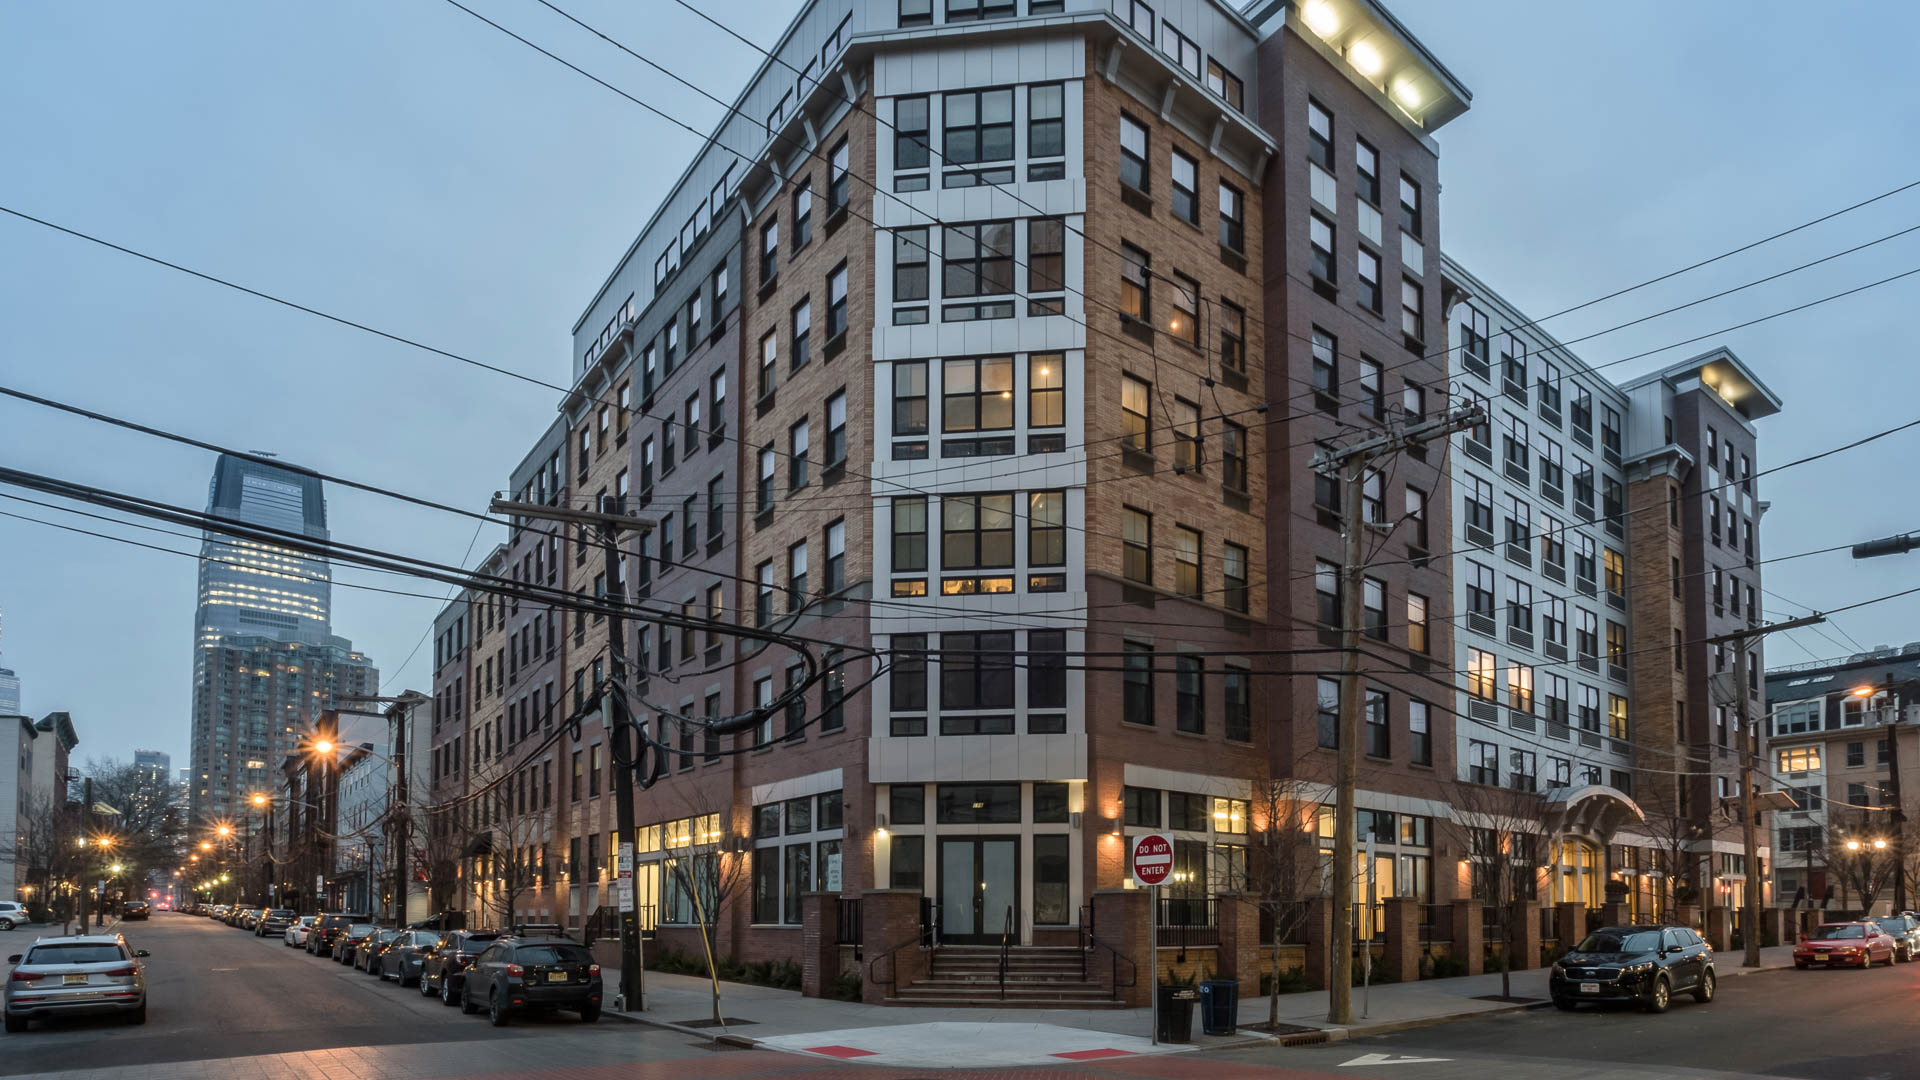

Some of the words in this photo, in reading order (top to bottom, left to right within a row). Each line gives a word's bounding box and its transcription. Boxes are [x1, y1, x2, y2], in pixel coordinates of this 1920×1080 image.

[1139, 846, 1149, 854] DO
[1153, 844, 1167, 853] NOT
[1141, 866, 1165, 876] ENTER
